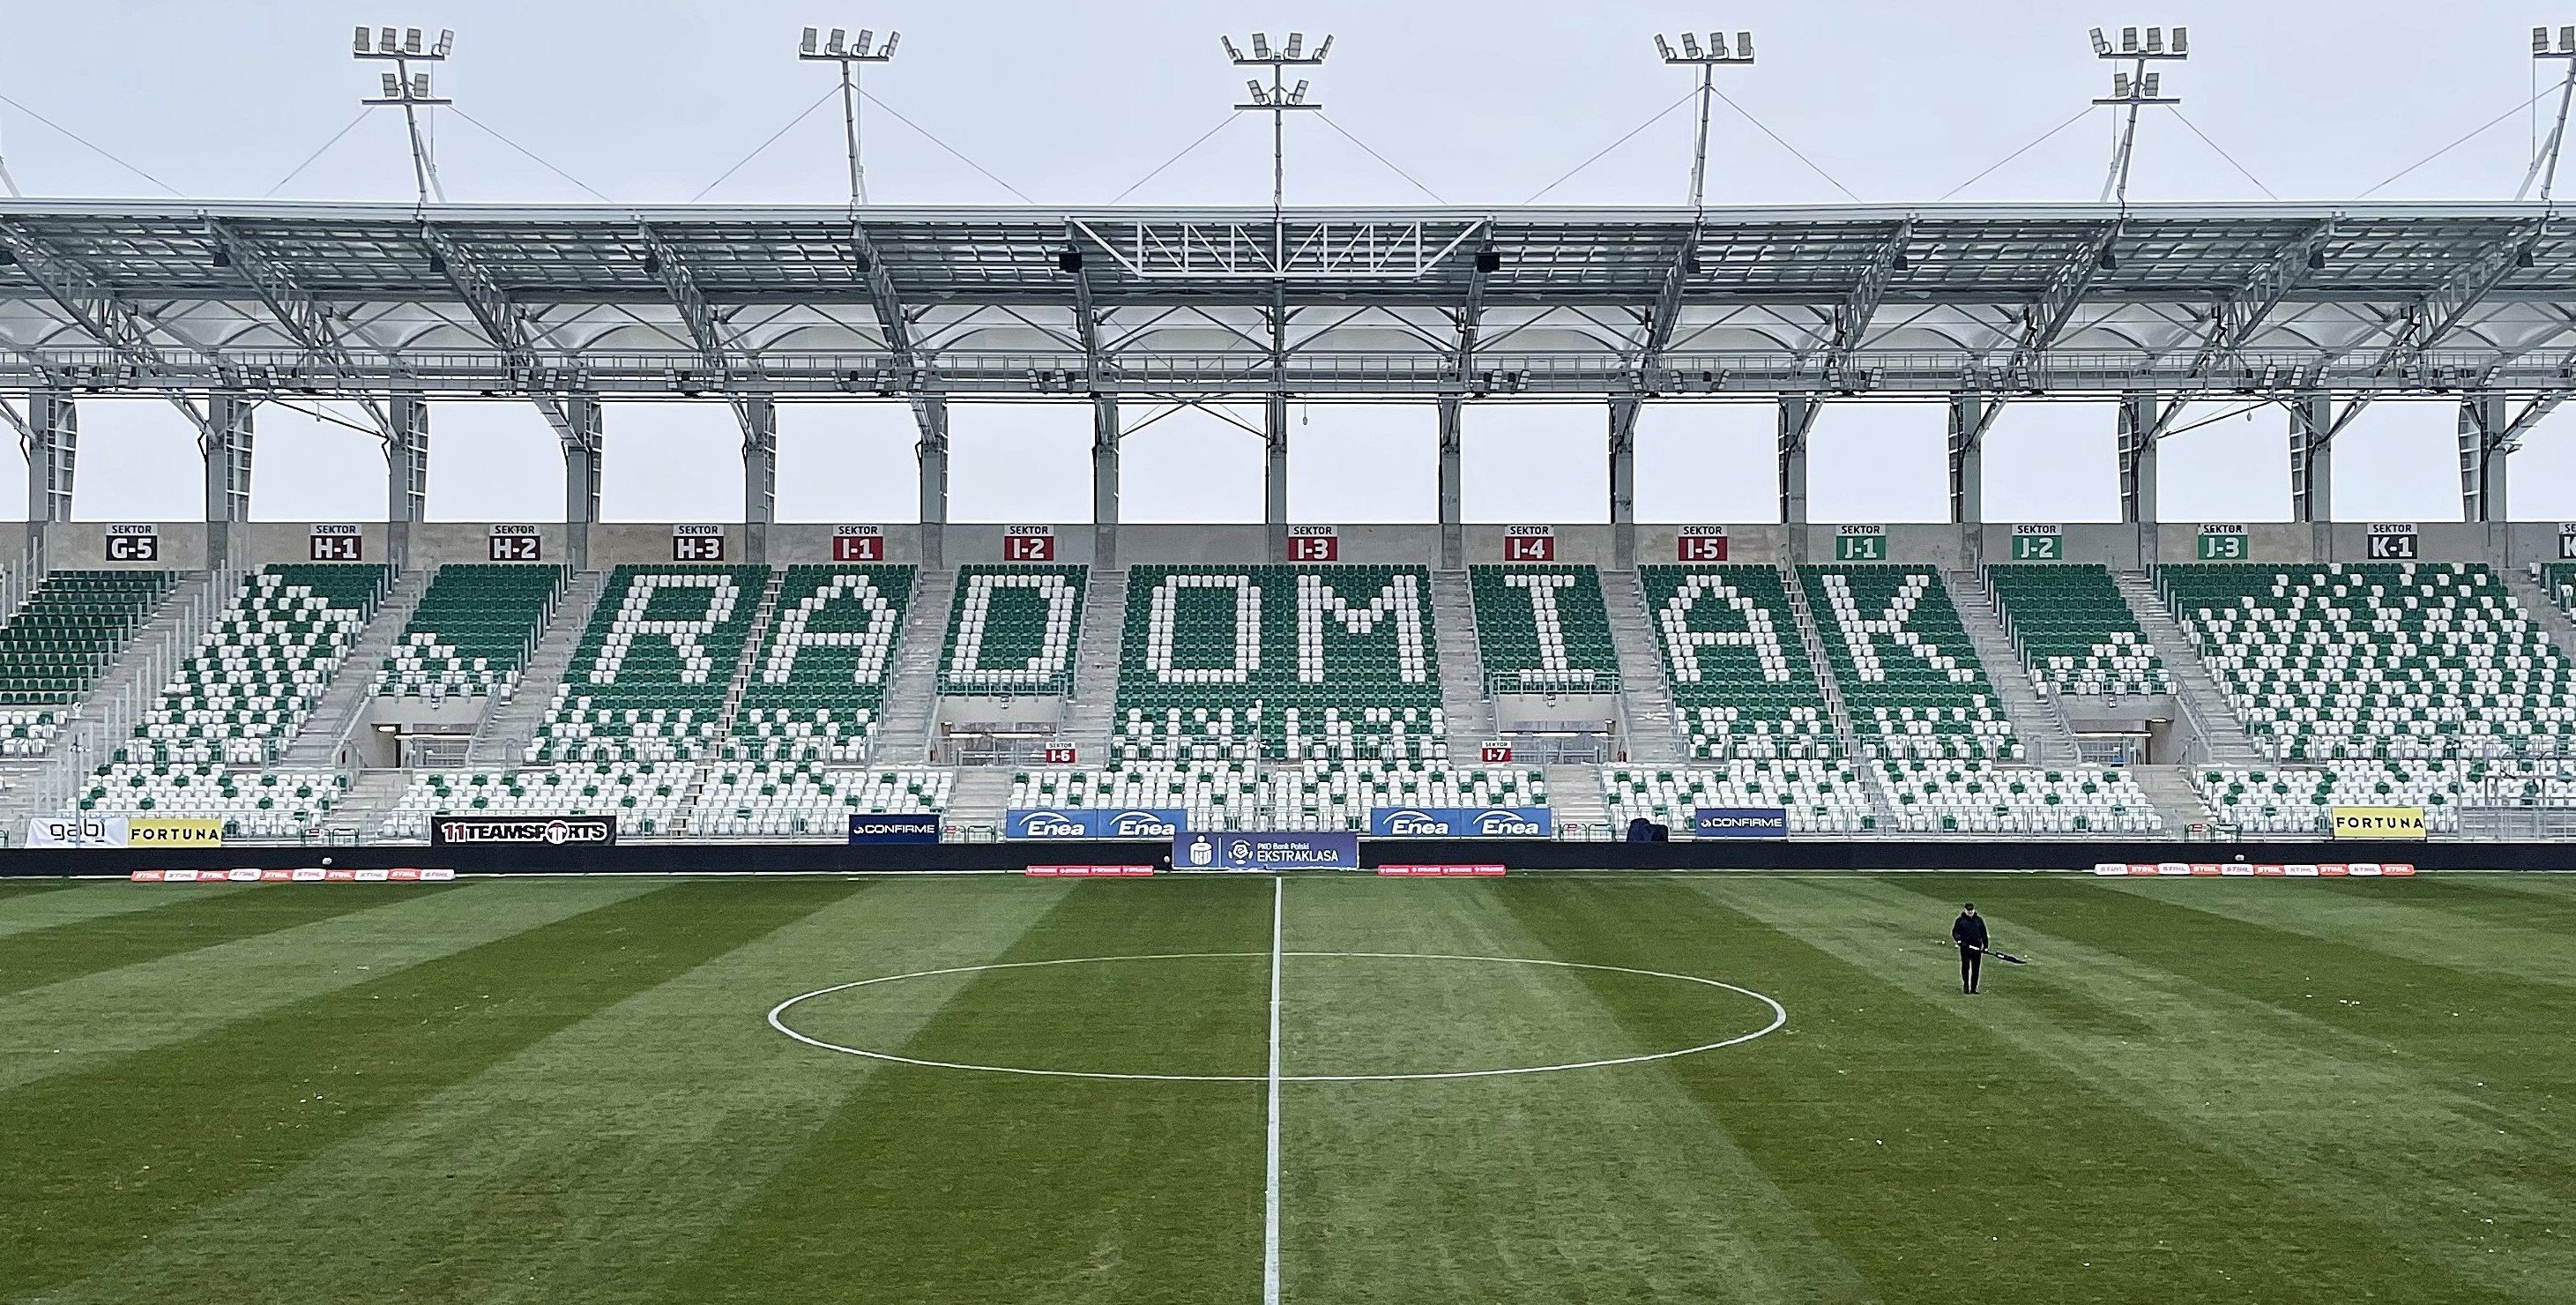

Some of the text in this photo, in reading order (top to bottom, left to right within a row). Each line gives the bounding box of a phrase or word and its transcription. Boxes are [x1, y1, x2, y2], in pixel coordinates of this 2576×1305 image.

[112, 525, 152, 533] SEKTOR
[316, 525, 356, 533] SEKTOR
[495, 525, 535, 534] SEKTOR
[678, 525, 718, 534] SEKTOR
[838, 526, 878, 534] SEKTOR
[1010, 526, 1048, 534] SEKTOR
[1294, 526, 1332, 534] SEKTOR
[1510, 526, 1549, 534] SEKTOR
[1683, 526, 1722, 534] SEKTOR
[1842, 525, 1880, 533] SEKTOR
[2017, 525, 2057, 533] SEKTOR
[2204, 525, 2243, 533] SEKTOR
[2373, 524, 2412, 533] SEKTOR
[111, 538, 153, 558] G-5
[315, 538, 356, 558] H-1
[494, 538, 537, 559] H-2
[677, 538, 719, 559] H-3
[843, 538, 874, 559] I-1
[1014, 538, 1045, 559] I-2
[1298, 539, 1329, 559] I-3
[1514, 539, 1545, 559] I-4
[1687, 538, 1718, 559] I-5
[1844, 538, 1877, 558] J-1
[2021, 537, 2053, 558] J-2
[2206, 537, 2239, 558] J-3
[2371, 537, 2413, 557] K-1
[1051, 750, 1070, 762] I-6
[1487, 749, 1506, 760] I-7
[1027, 820, 1085, 836] Enea
[1118, 820, 1175, 836] Enea
[1392, 819, 1449, 835] Enea
[1481, 819, 1539, 835] Enea
[1712, 817, 1783, 827] CONFIRME
[2336, 817, 2423, 828] FORTUNA
[131, 829, 220, 839] FORTUNA
[865, 824, 935, 834] CONFIRME
[1257, 850, 1339, 862] EKSTRAKLASA
